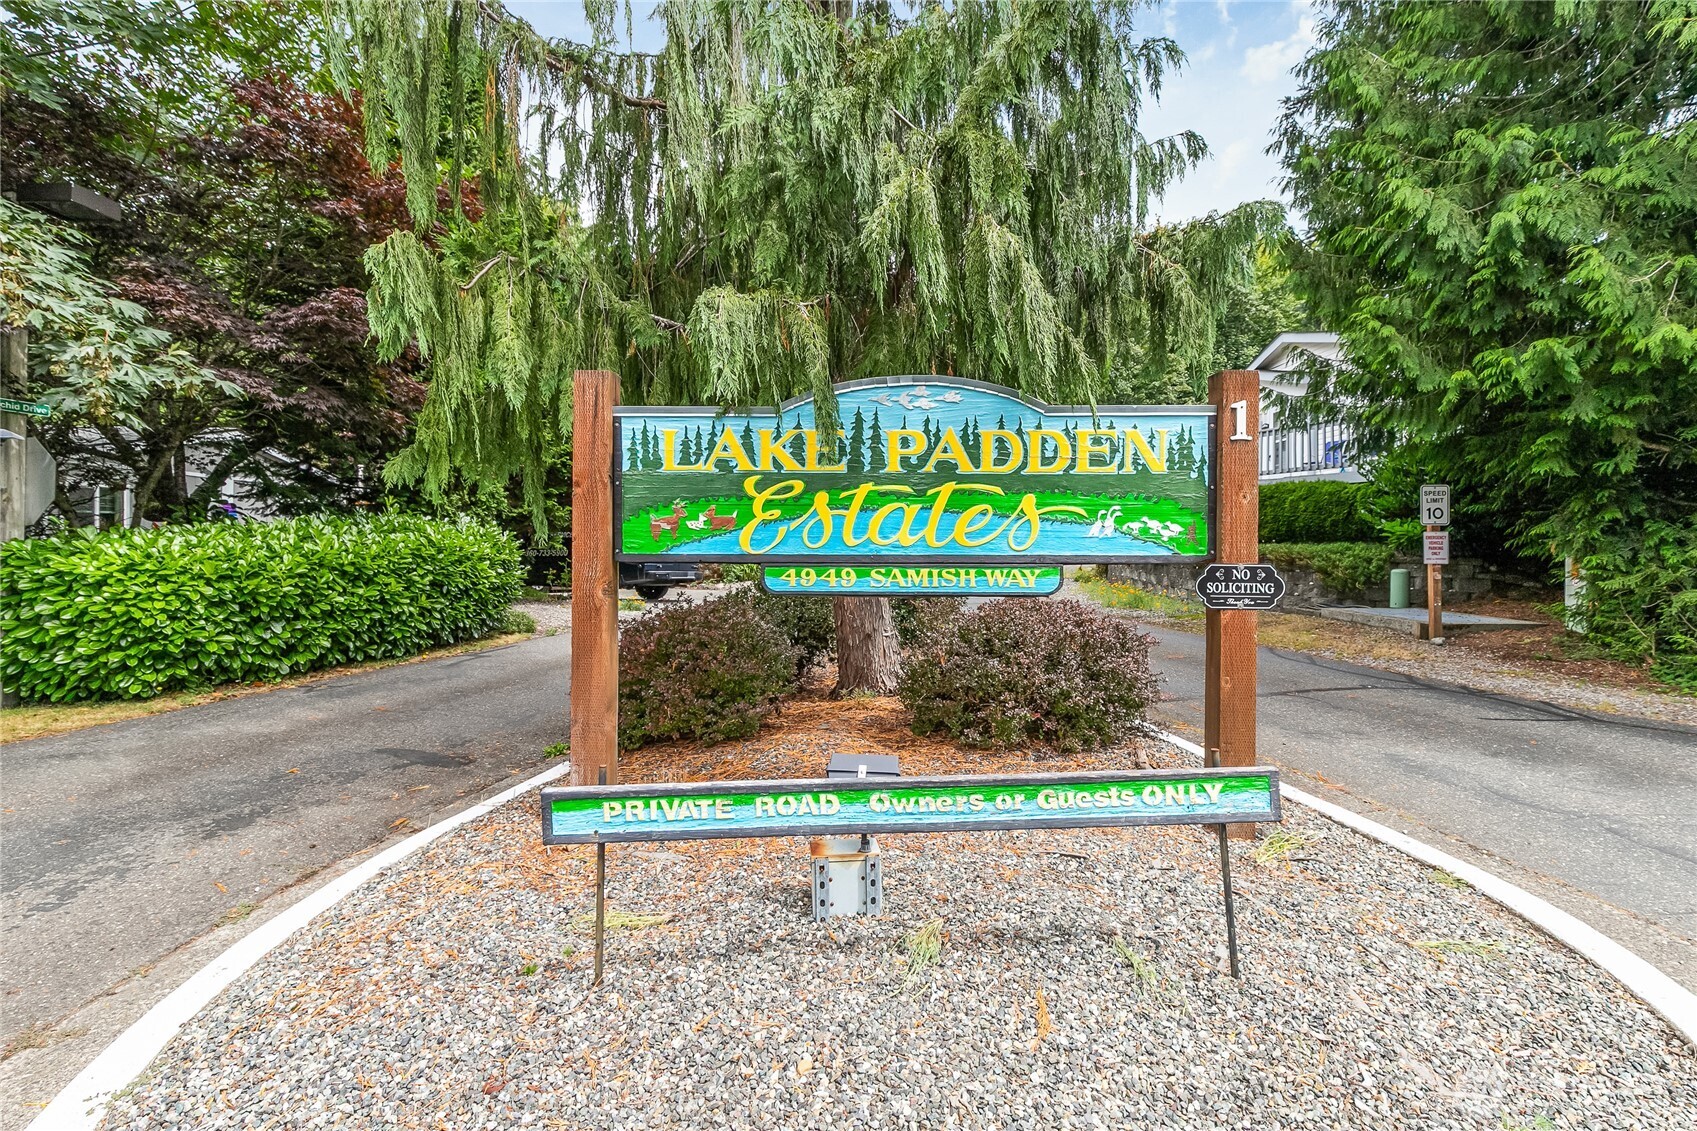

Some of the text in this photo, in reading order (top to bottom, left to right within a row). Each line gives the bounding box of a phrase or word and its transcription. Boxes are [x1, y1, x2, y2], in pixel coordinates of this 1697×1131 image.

[22, 404, 47, 414] Drive
[1230, 399, 1253, 441] 1
[661, 425, 1170, 474] LAKE PADDEN
[738, 475, 1089, 555] Estates
[1426, 507, 1444, 520] 10
[779, 567, 1042, 588] 4949 SAMISH WAY
[1232, 569, 1250, 580] NO
[1206, 582, 1275, 595] SOLICITING
[602, 782, 1225, 823] PRIVATE ROAD Owners or Guests ONLY
